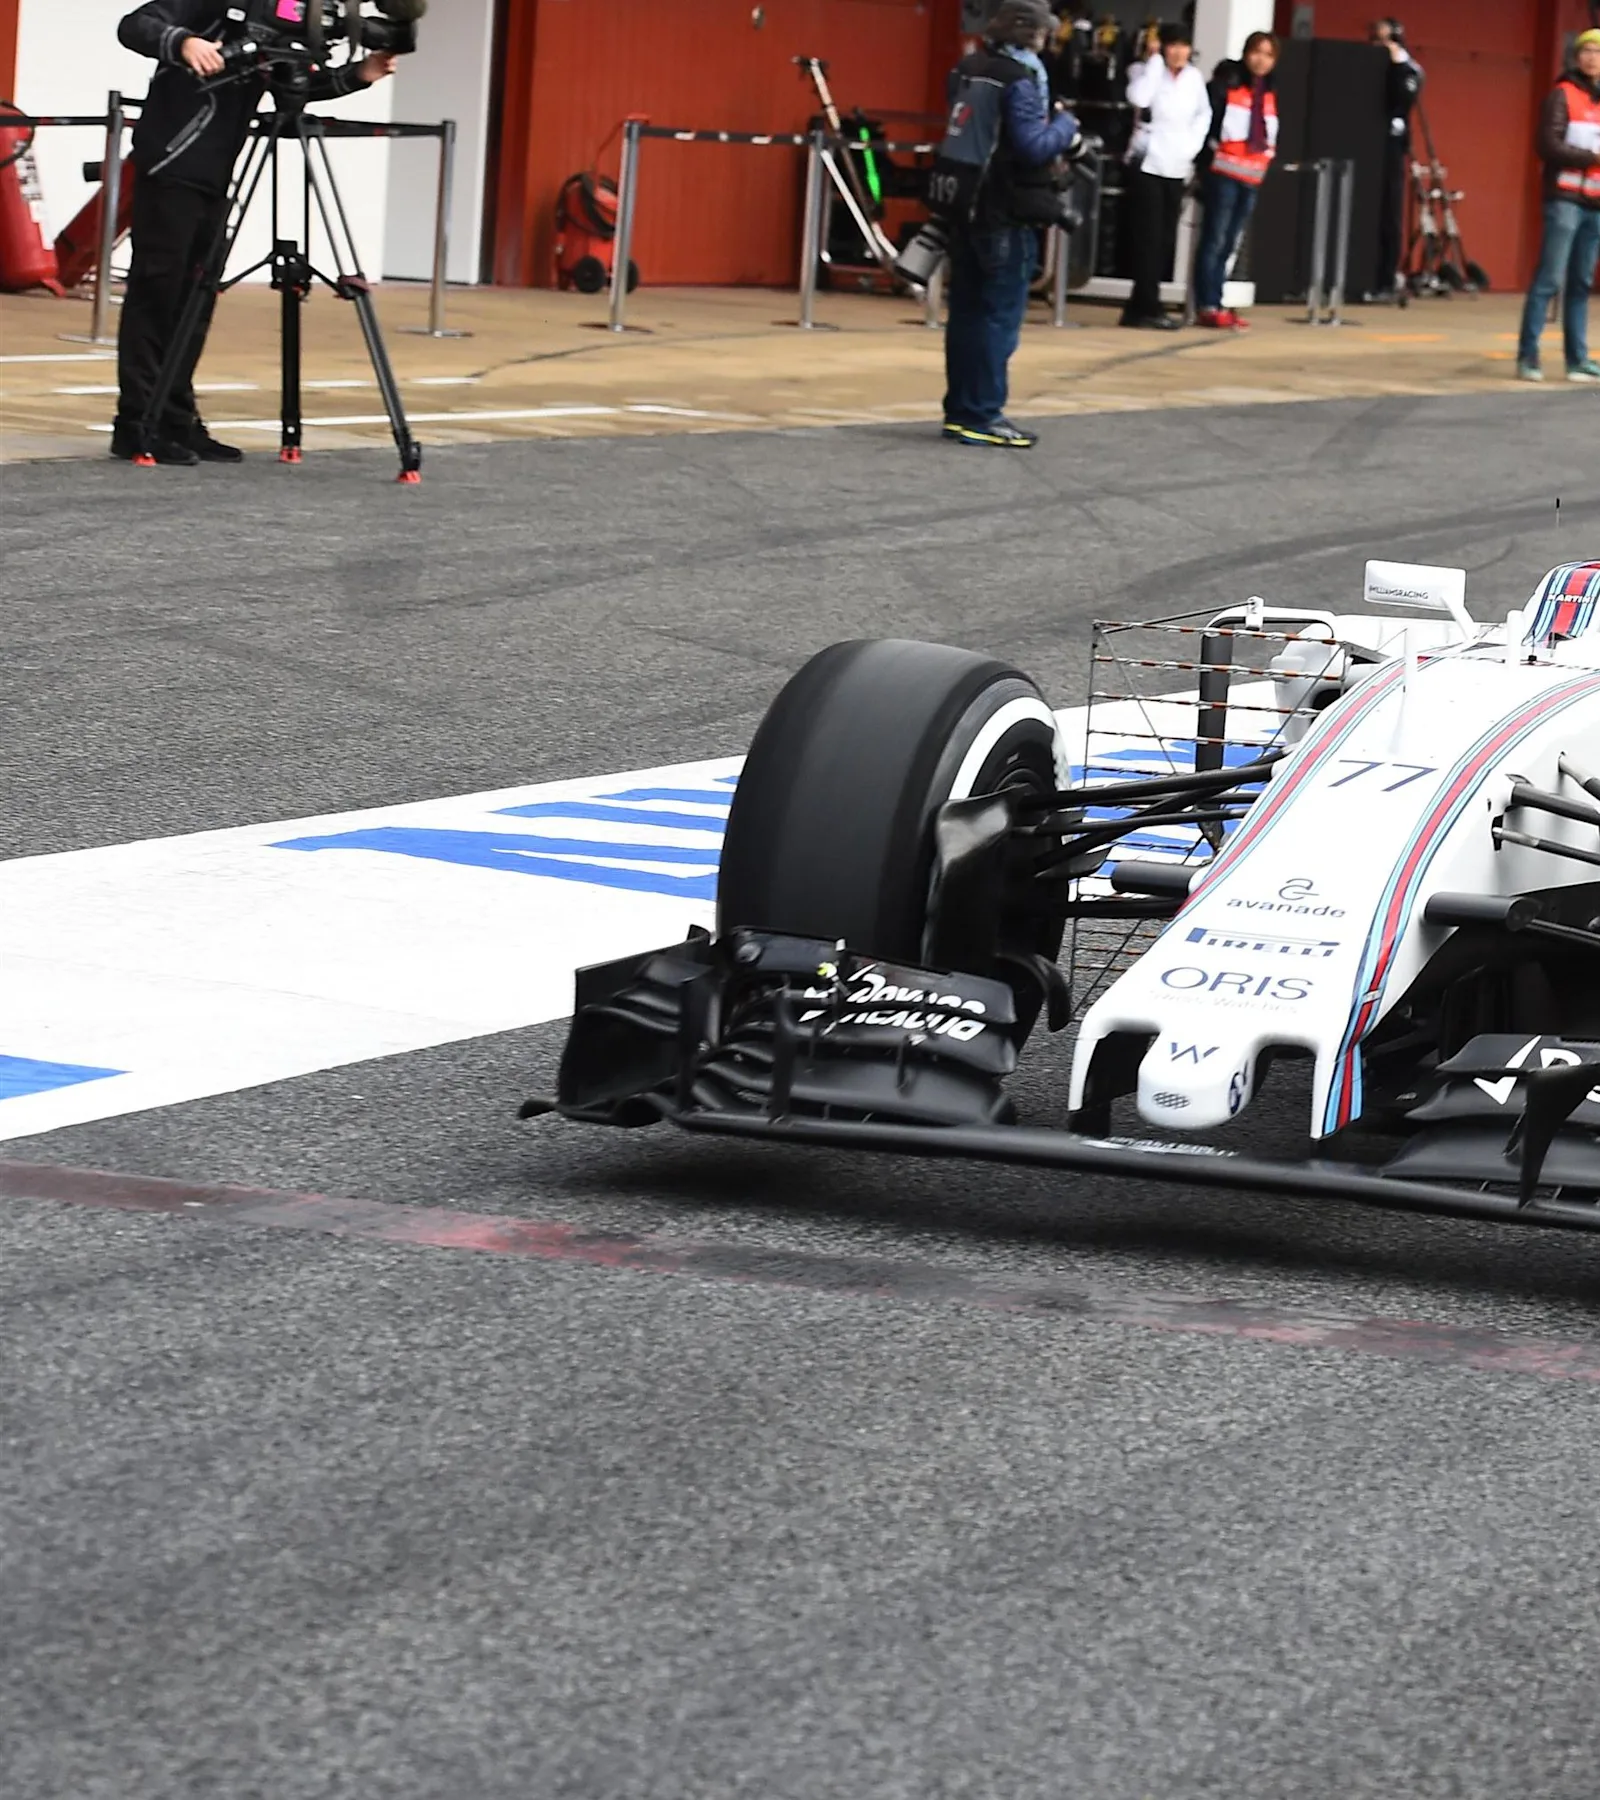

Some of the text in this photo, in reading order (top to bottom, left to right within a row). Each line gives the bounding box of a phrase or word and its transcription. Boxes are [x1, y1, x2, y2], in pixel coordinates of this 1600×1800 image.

[1548, 594, 1595, 605] MARTINI
[1328, 759, 1440, 792] 77
[1227, 898, 1347, 918] avanade
[1185, 927, 1341, 957] PIRELLI
[1161, 967, 1314, 1001] ORIS
